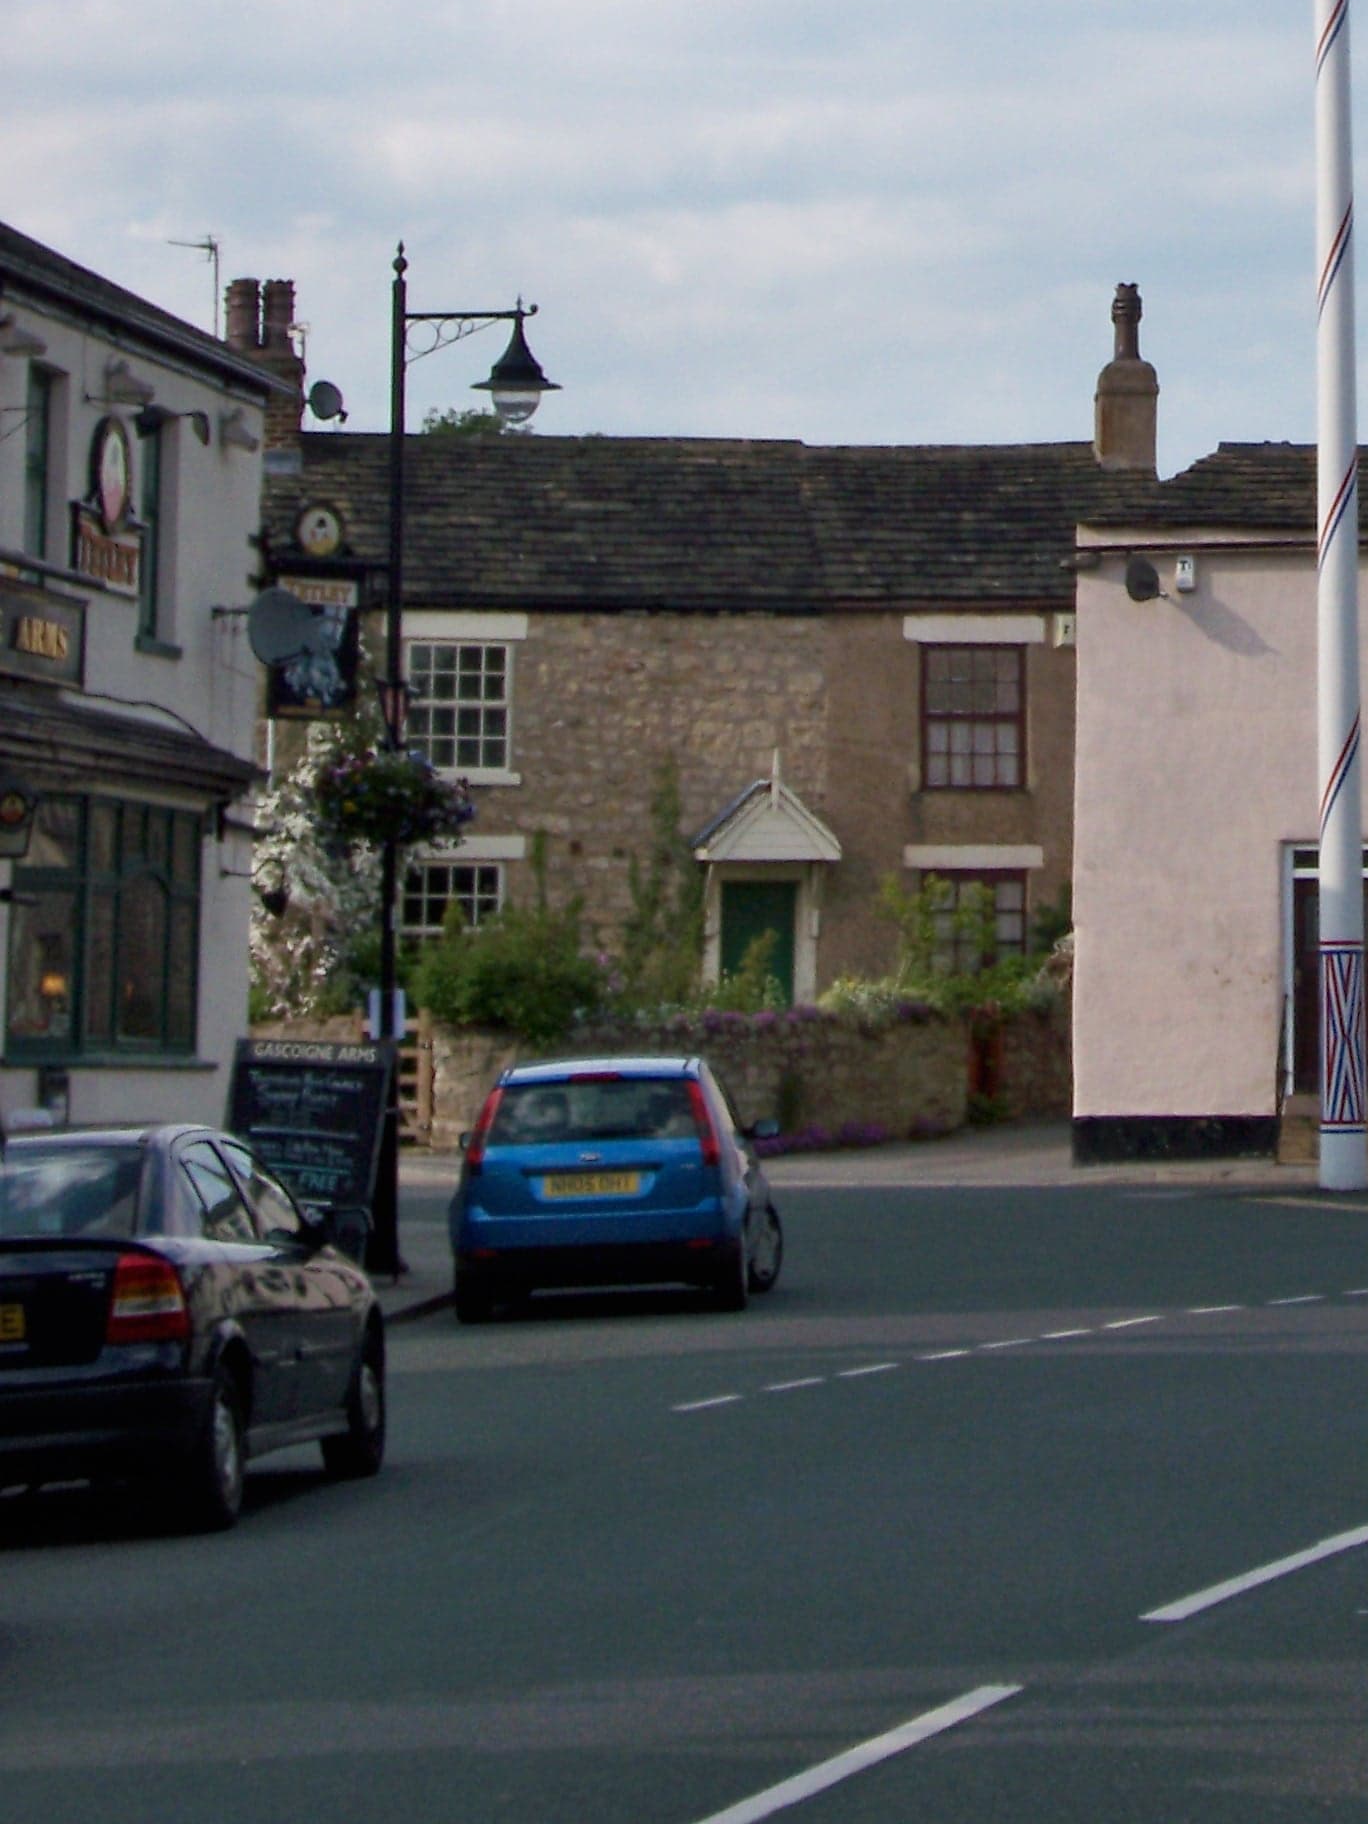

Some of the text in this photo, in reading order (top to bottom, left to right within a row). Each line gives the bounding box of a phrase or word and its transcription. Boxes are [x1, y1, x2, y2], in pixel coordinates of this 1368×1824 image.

[16, 616, 69, 660] ARMS
[254, 1042, 377, 1063] GASCOIGNE ARMS
